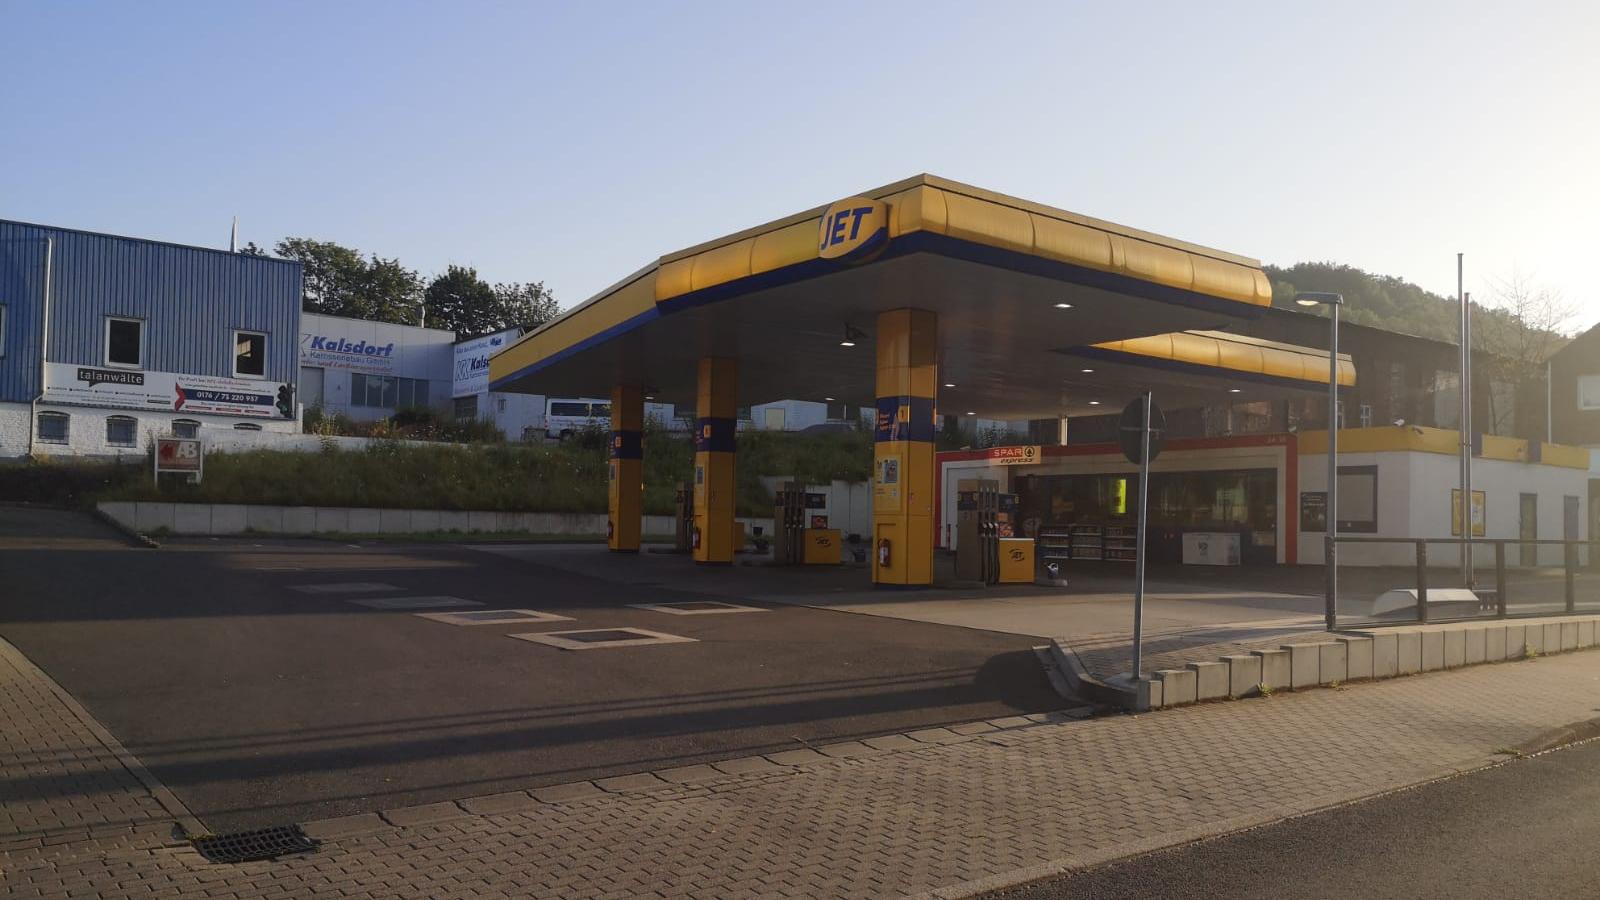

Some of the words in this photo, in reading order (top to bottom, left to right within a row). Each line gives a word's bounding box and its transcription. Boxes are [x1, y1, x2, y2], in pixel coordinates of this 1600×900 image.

[820, 207, 873, 250] JET
[311, 336, 394, 356] Kalsdorf
[79, 370, 143, 385] talanwälte
[196, 391, 213, 399] 0176
[994, 448, 1022, 457] SPAR
